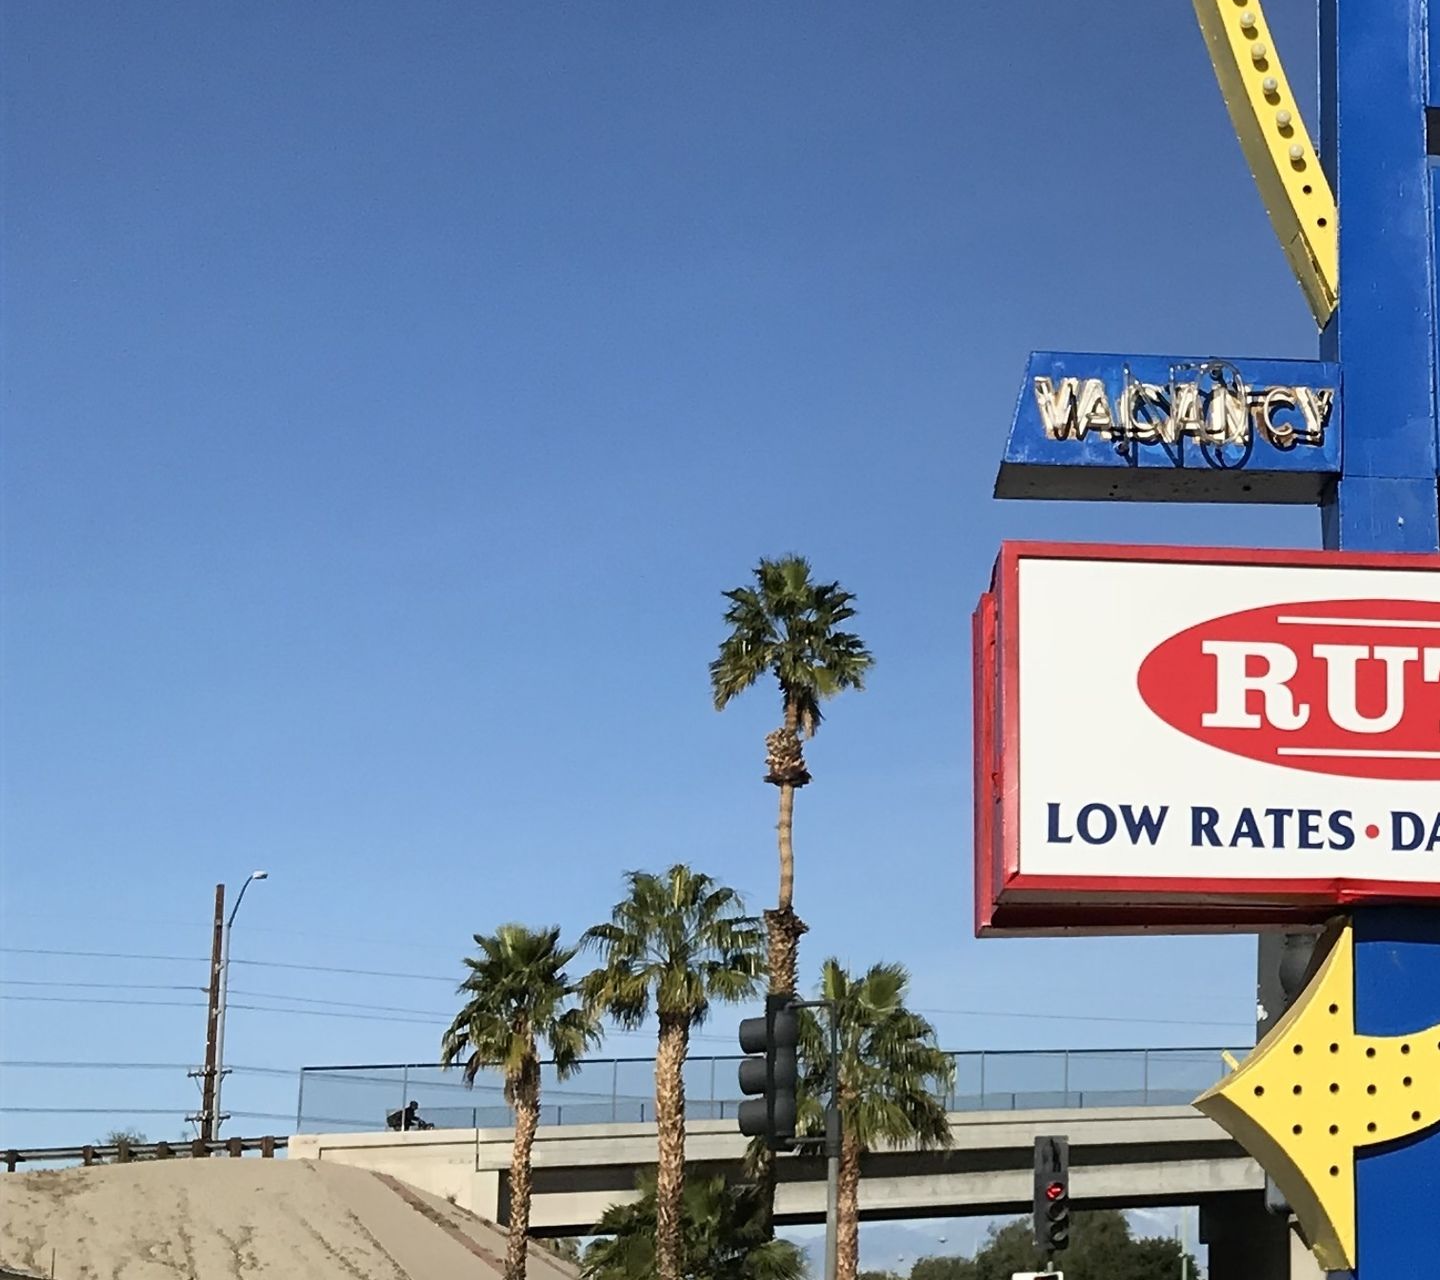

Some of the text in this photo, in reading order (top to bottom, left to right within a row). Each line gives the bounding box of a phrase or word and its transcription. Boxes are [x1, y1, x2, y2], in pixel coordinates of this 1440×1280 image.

[1033, 376, 1335, 447] VACANCY
[1047, 802, 1169, 846] LOW
[1190, 806, 1355, 851] RATES
